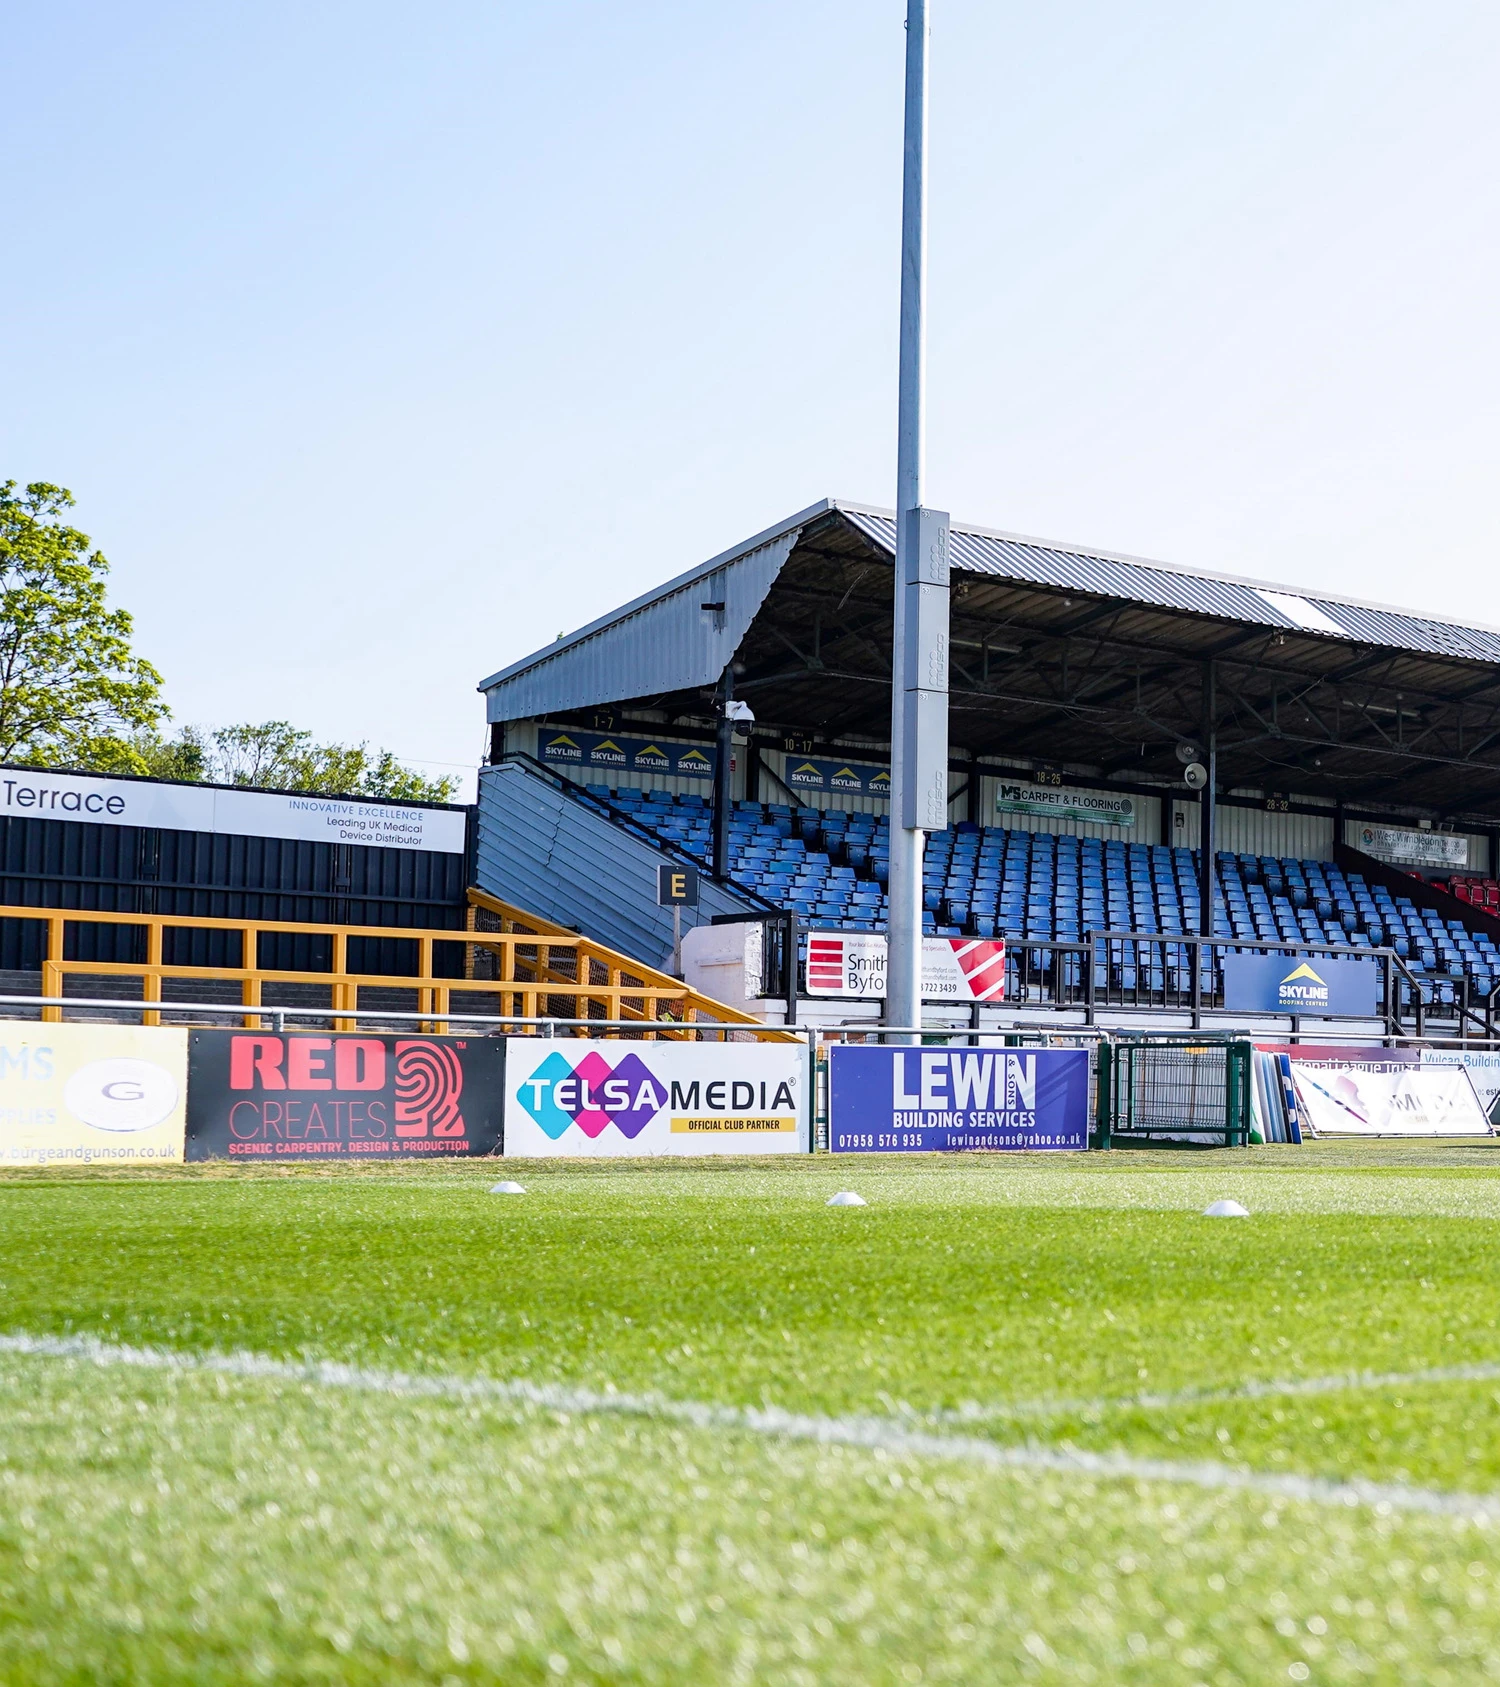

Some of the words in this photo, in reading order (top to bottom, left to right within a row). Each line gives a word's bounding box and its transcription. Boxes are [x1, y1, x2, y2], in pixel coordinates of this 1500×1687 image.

[545, 747, 582, 757] SKYLINE
[590, 752, 626, 762] SKYLINE
[634, 756, 669, 767] SKYLINE
[677, 761, 712, 771] SKYLINE
[791, 773, 823, 784] SKYLINE
[831, 778, 862, 788] SKYLINE
[869, 782, 890, 791] SKYLI
[3, 780, 125, 815] Terrace
[1021, 790, 1061, 804] CARPET
[1063, 795, 1071, 804] &
[1072, 797, 1121, 811] FLOORING
[289, 801, 354, 814] INNOVATIVE
[358, 807, 423, 821] EXCELLENCE
[327, 817, 366, 829] Leading
[368, 820, 381, 829] UK
[383, 822, 423, 833] Medical
[340, 830, 373, 841] Device
[375, 833, 422, 845] Distributor
[1377, 830, 1395, 841] West
[1395, 832, 1441, 845] Wimbledon
[671, 873, 686, 898] E
[848, 953, 888, 971] Smith
[849, 972, 884, 995] Byfo
[939, 983, 957, 992] 3439
[1279, 985, 1328, 999] SKYLINE
[230, 1036, 386, 1091] RED
[893, 1052, 1036, 1110] LEWIN
[102, 1081, 144, 1101] G
[526, 1079, 660, 1111] TELSA
[671, 1081, 796, 1110] MEDIA
[229, 1101, 387, 1139] CREATES
[689, 1120, 722, 1130] OFFICIAL
[724, 1120, 744, 1130] CLUB
[747, 1120, 780, 1130] PARTNER
[893, 1112, 963, 1128] BUILDING
[969, 1111, 1036, 1128] SERVICES
[228, 1143, 273, 1155] SCENIC
[349, 1141, 389, 1152] DESIGN
[392, 1141, 400, 1151] &
[402, 1140, 469, 1151] PRODUCTION
[839, 1134, 873, 1148] 07958
[879, 1133, 898, 1147] 576
[903, 1133, 922, 1146] 935
[947, 1132, 1081, 1147] lewinandsons@yahoo.co.uk
